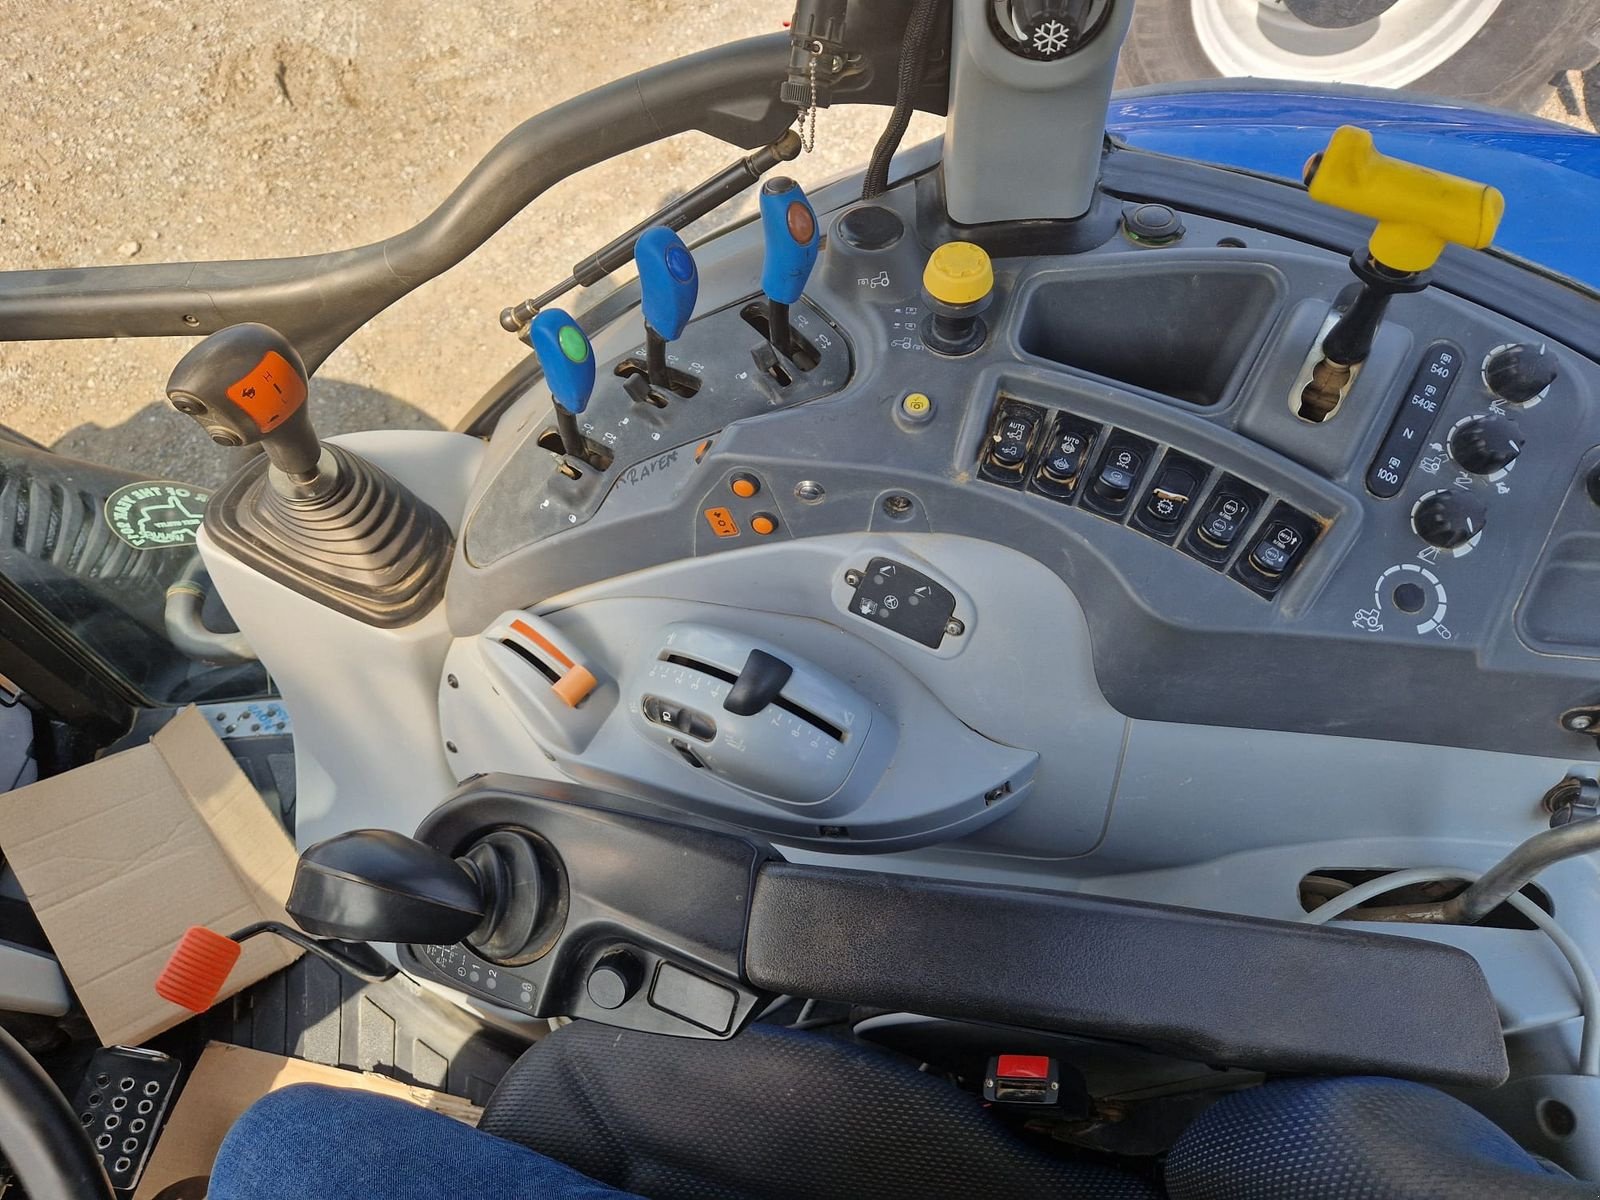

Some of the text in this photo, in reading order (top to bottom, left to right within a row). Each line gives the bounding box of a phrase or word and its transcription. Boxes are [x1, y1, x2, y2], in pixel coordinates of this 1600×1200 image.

[263, 370, 273, 382] H
[1430, 363, 1450, 378] 540
[1411, 394, 1438, 413] 540E
[1009, 422, 1025, 431] AUTO
[1402, 427, 1415, 440] N
[1063, 435, 1080, 445] AUTO
[1377, 467, 1399, 485] 1000
[826, 748, 837, 760] 10
[488, 969, 498, 978] 2
